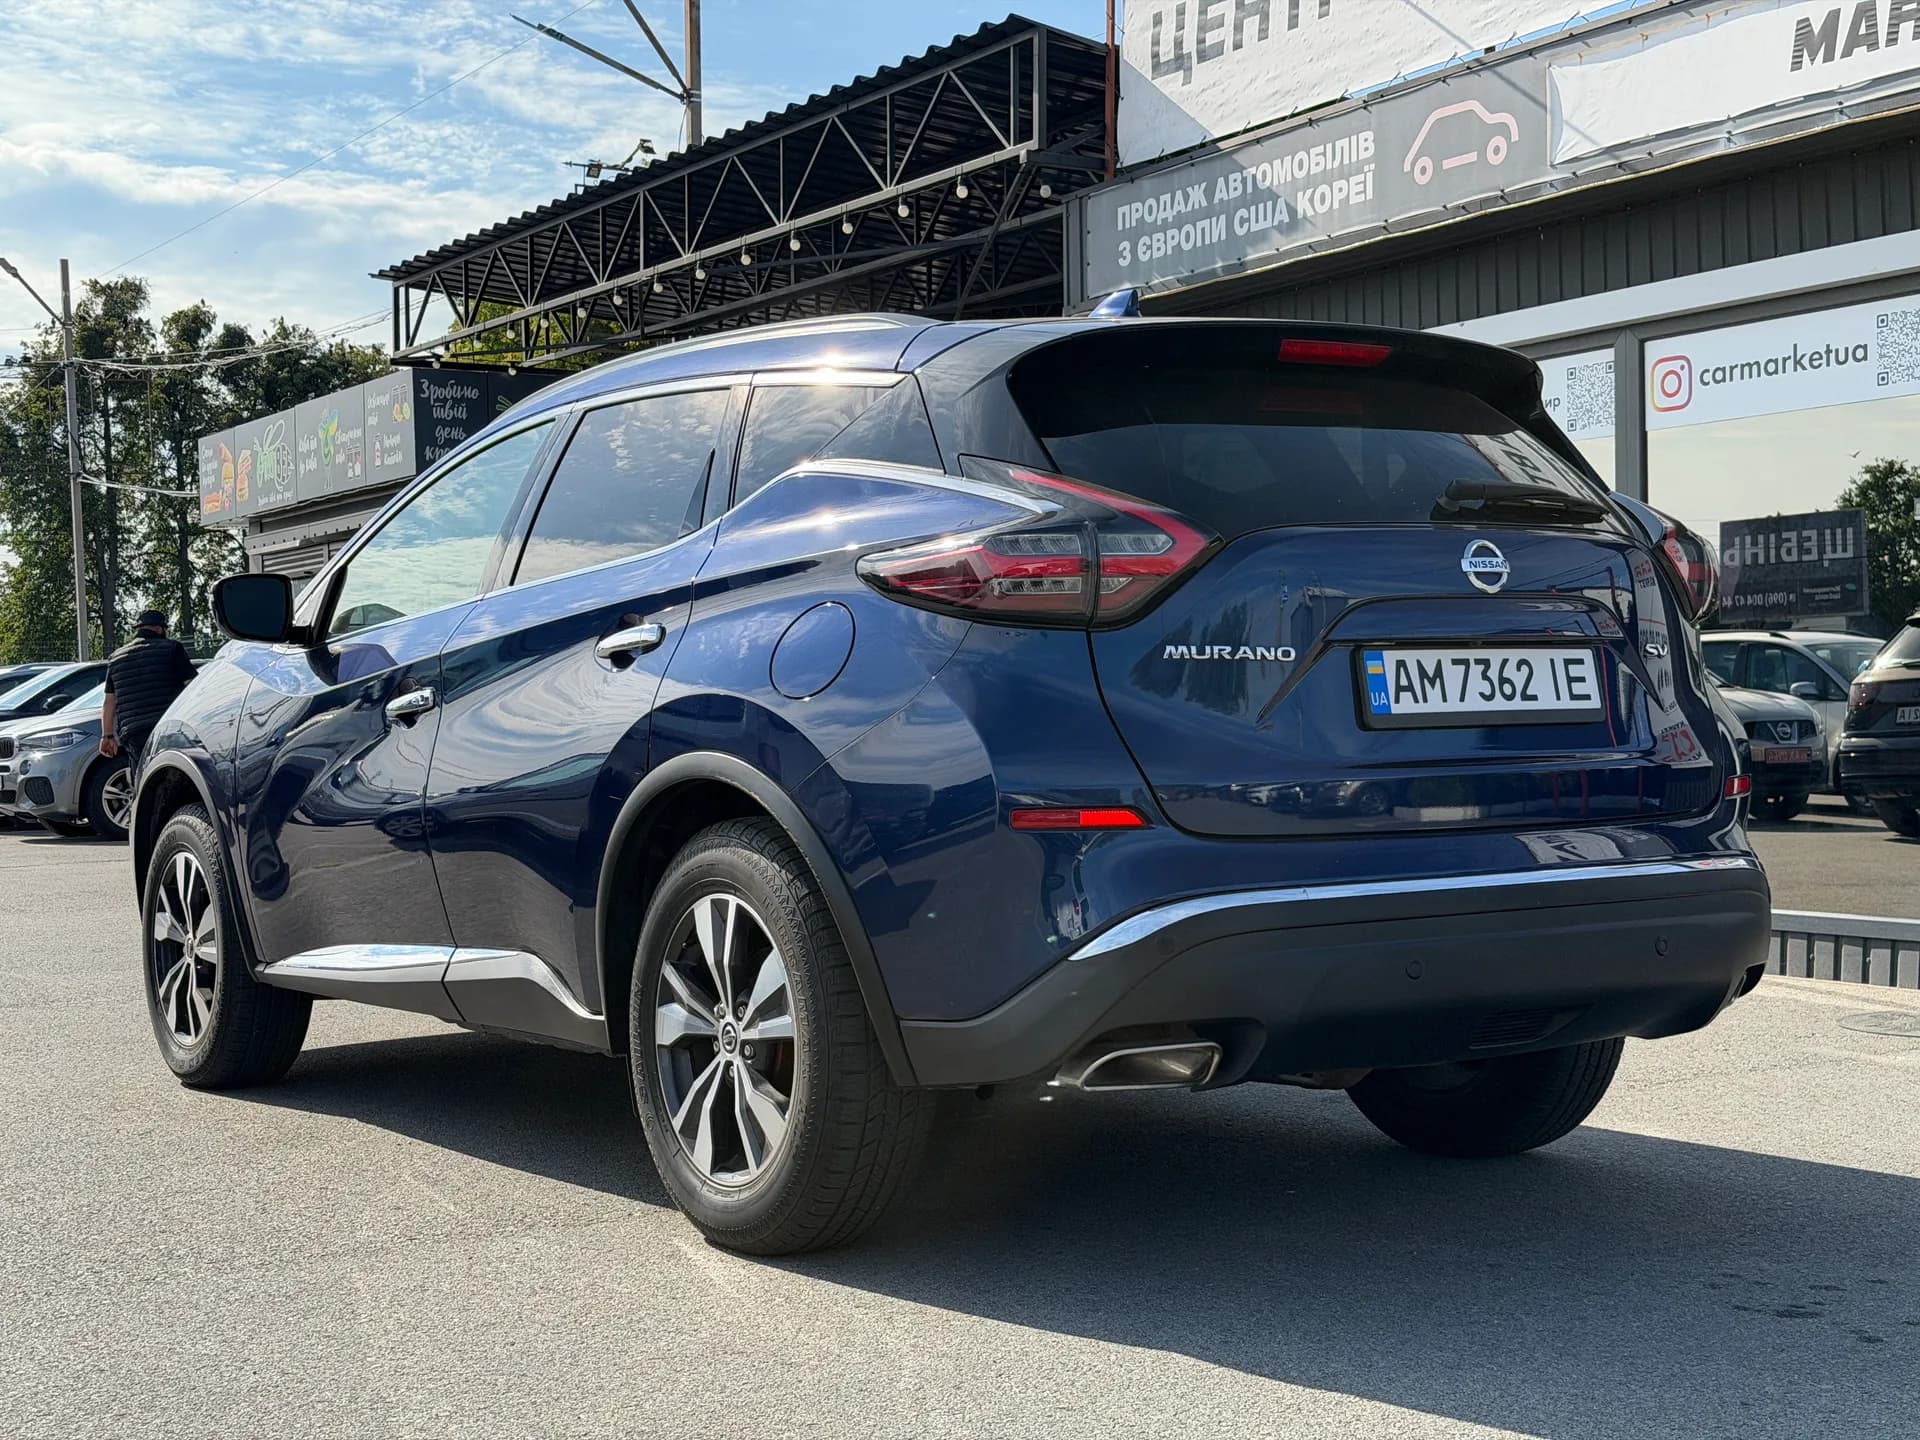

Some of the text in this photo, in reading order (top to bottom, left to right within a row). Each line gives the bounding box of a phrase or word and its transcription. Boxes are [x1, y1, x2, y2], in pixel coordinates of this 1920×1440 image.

[1117, 130, 1376, 231] ПРОДАЖ АВТОМОБІЛІВ
[1117, 164, 1376, 267] З ЄВРОПИ США КОРЕЇ
[1699, 343, 1868, 386] carmarketua
[435, 424, 467, 445] день
[1468, 560, 1508, 569] NISSAN
[1162, 645, 1297, 661] MURANO
[1645, 643, 1668, 656] SV
[1370, 692, 1389, 707] UA
